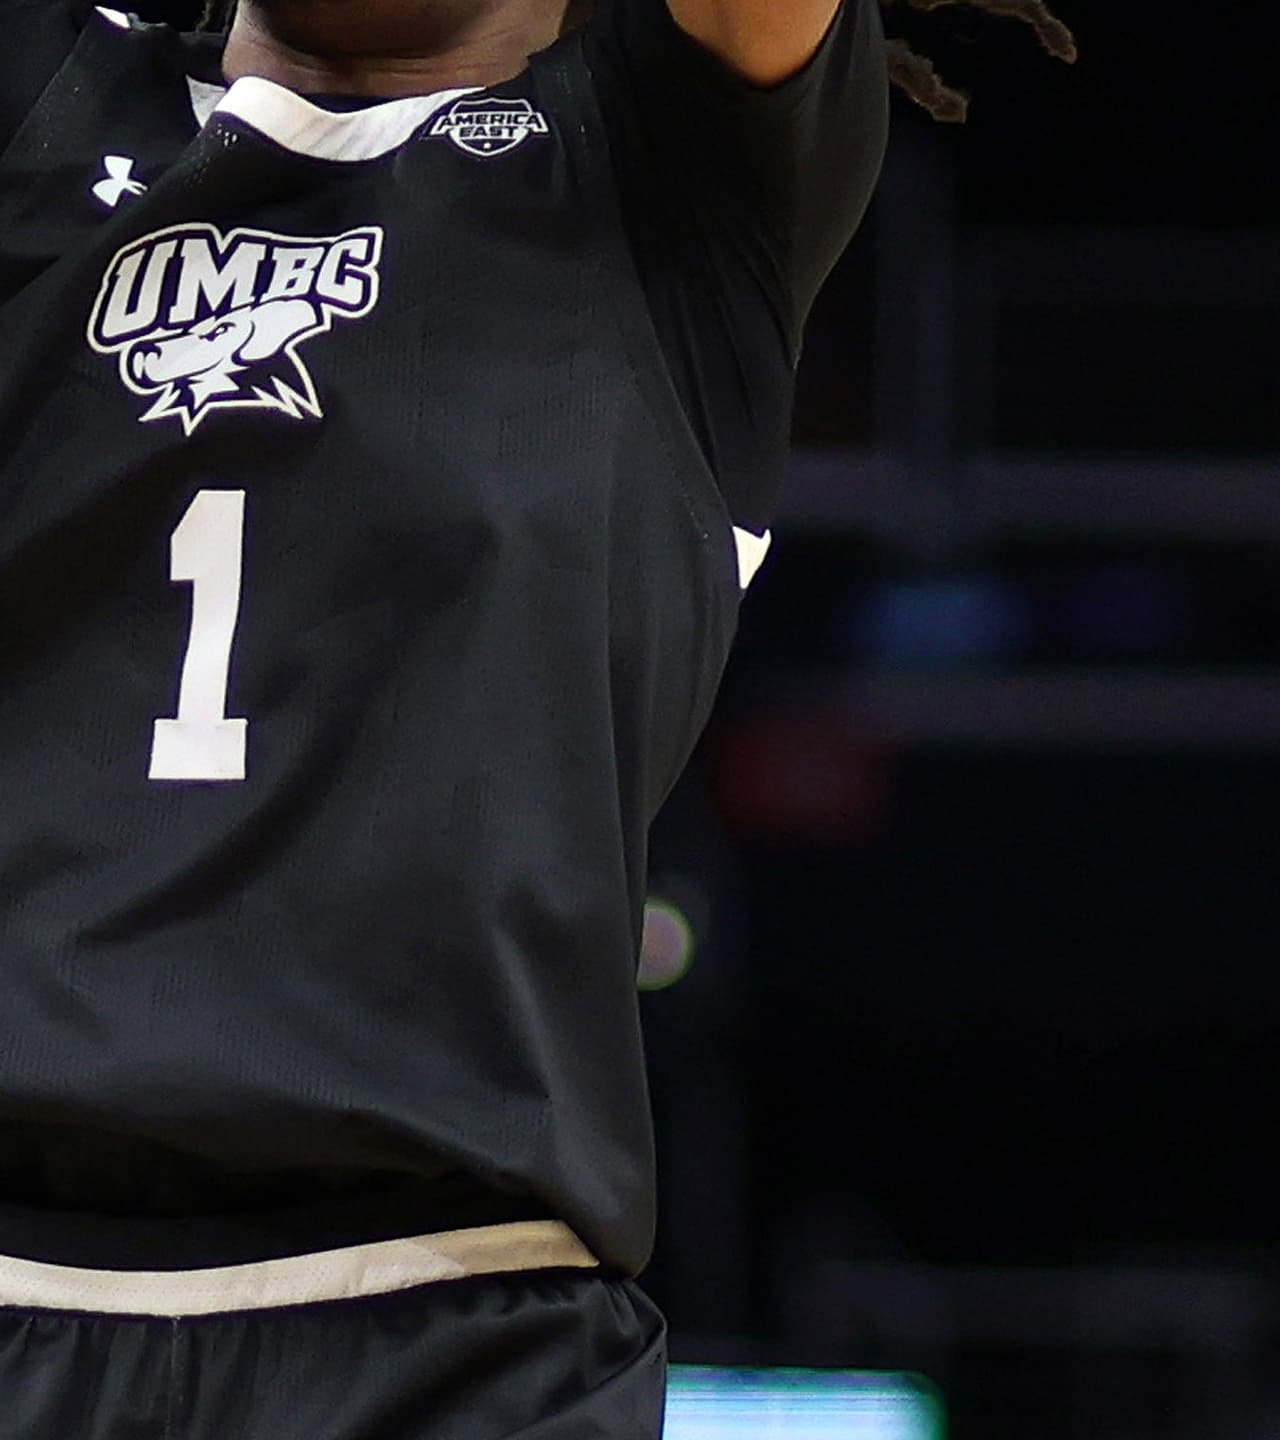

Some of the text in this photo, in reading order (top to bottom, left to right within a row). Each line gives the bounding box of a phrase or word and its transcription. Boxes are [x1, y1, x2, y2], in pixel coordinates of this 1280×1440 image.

[434, 113, 545, 132] AMERICA
[459, 125, 517, 138] EAST
[101, 237, 370, 339] UMBC
[148, 489, 249, 781] 1
